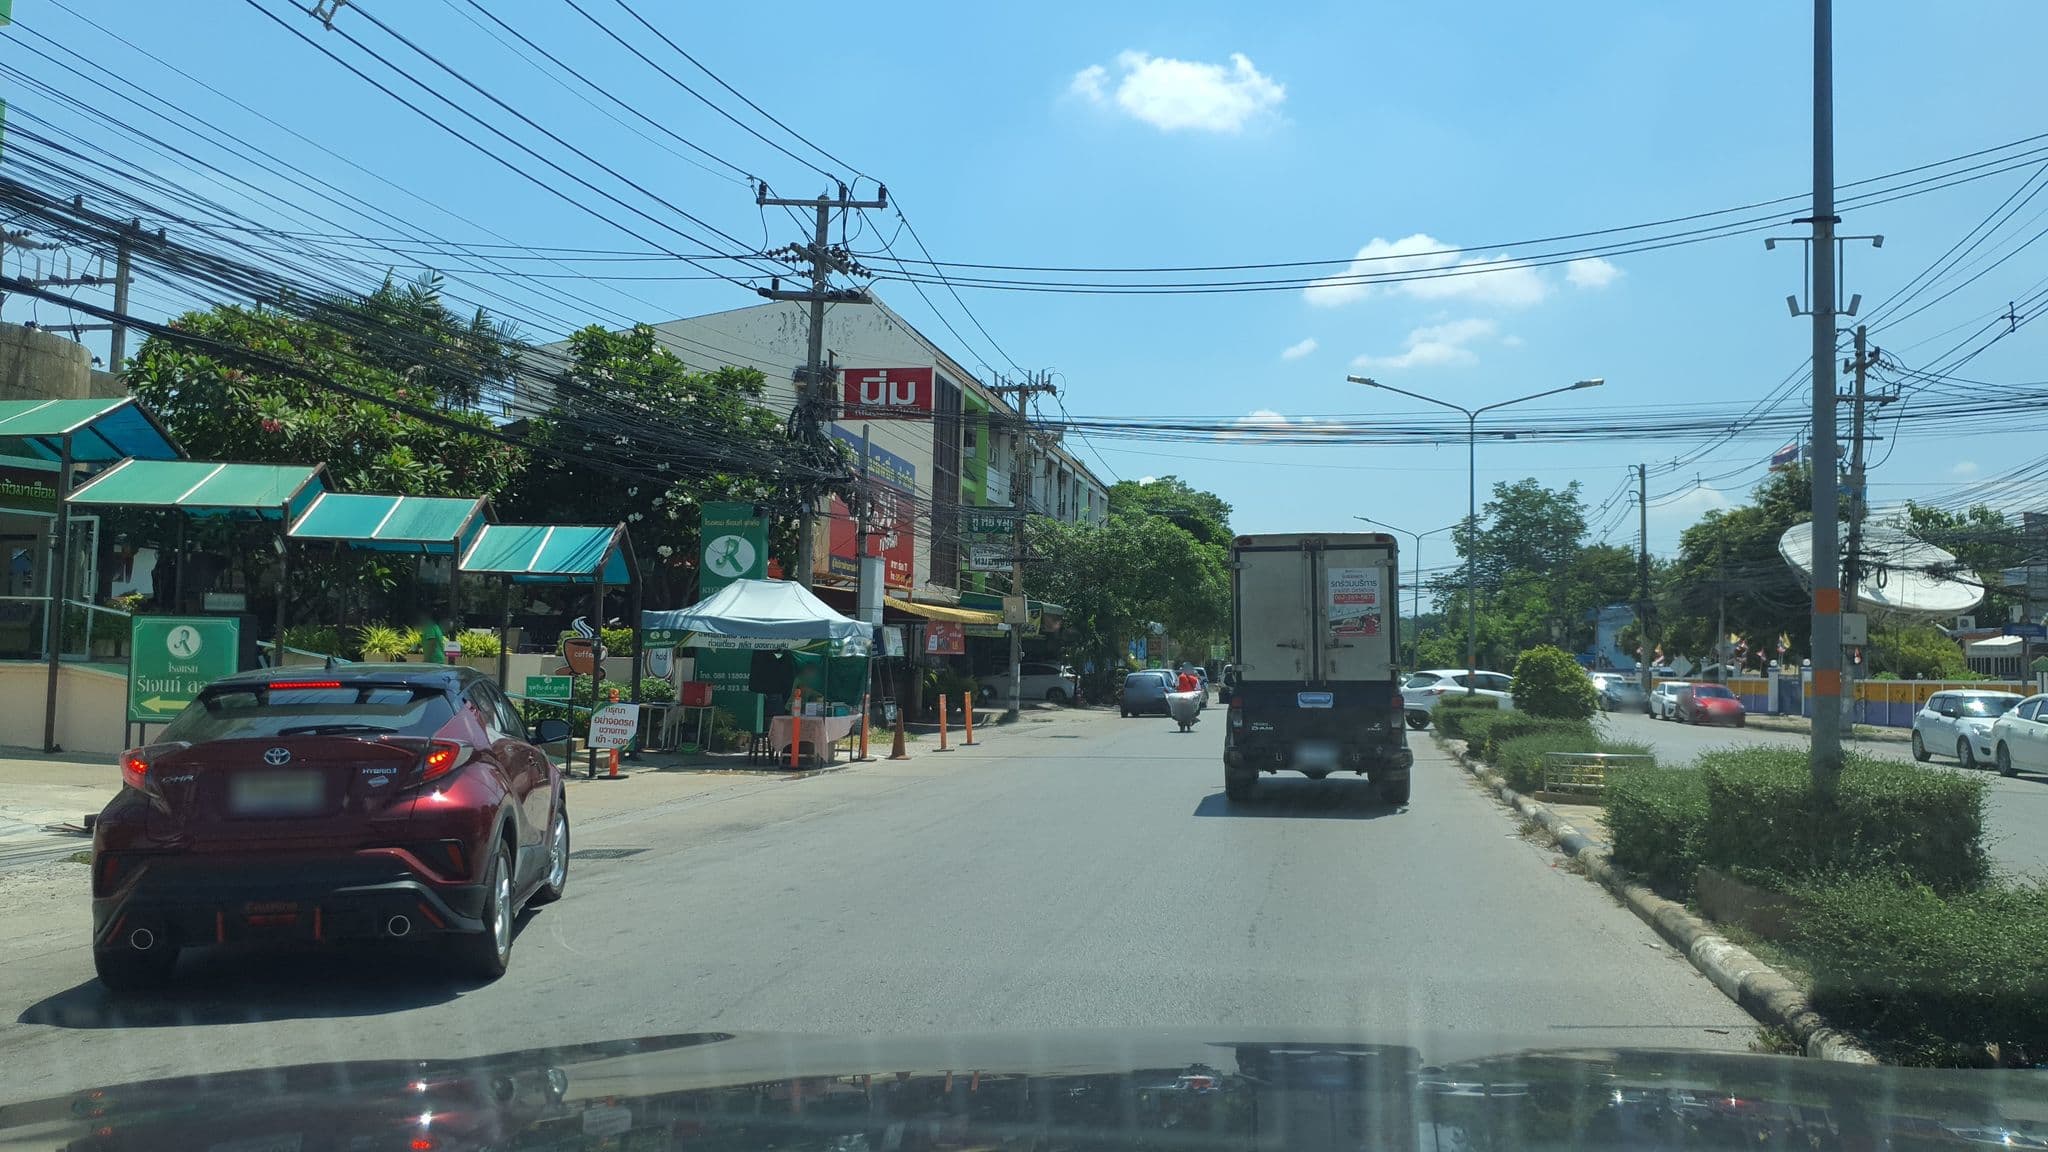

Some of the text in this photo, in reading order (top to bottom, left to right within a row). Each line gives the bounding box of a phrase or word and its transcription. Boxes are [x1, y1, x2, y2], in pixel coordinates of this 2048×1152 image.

[0, 478, 56, 499] ก้วมาเฮือน
[605, 706, 626, 716] กรุณา
[594, 714, 635, 727] อย่าจอดรถ
[595, 734, 606, 744] เข้า
[612, 737, 629, 745] ออก
